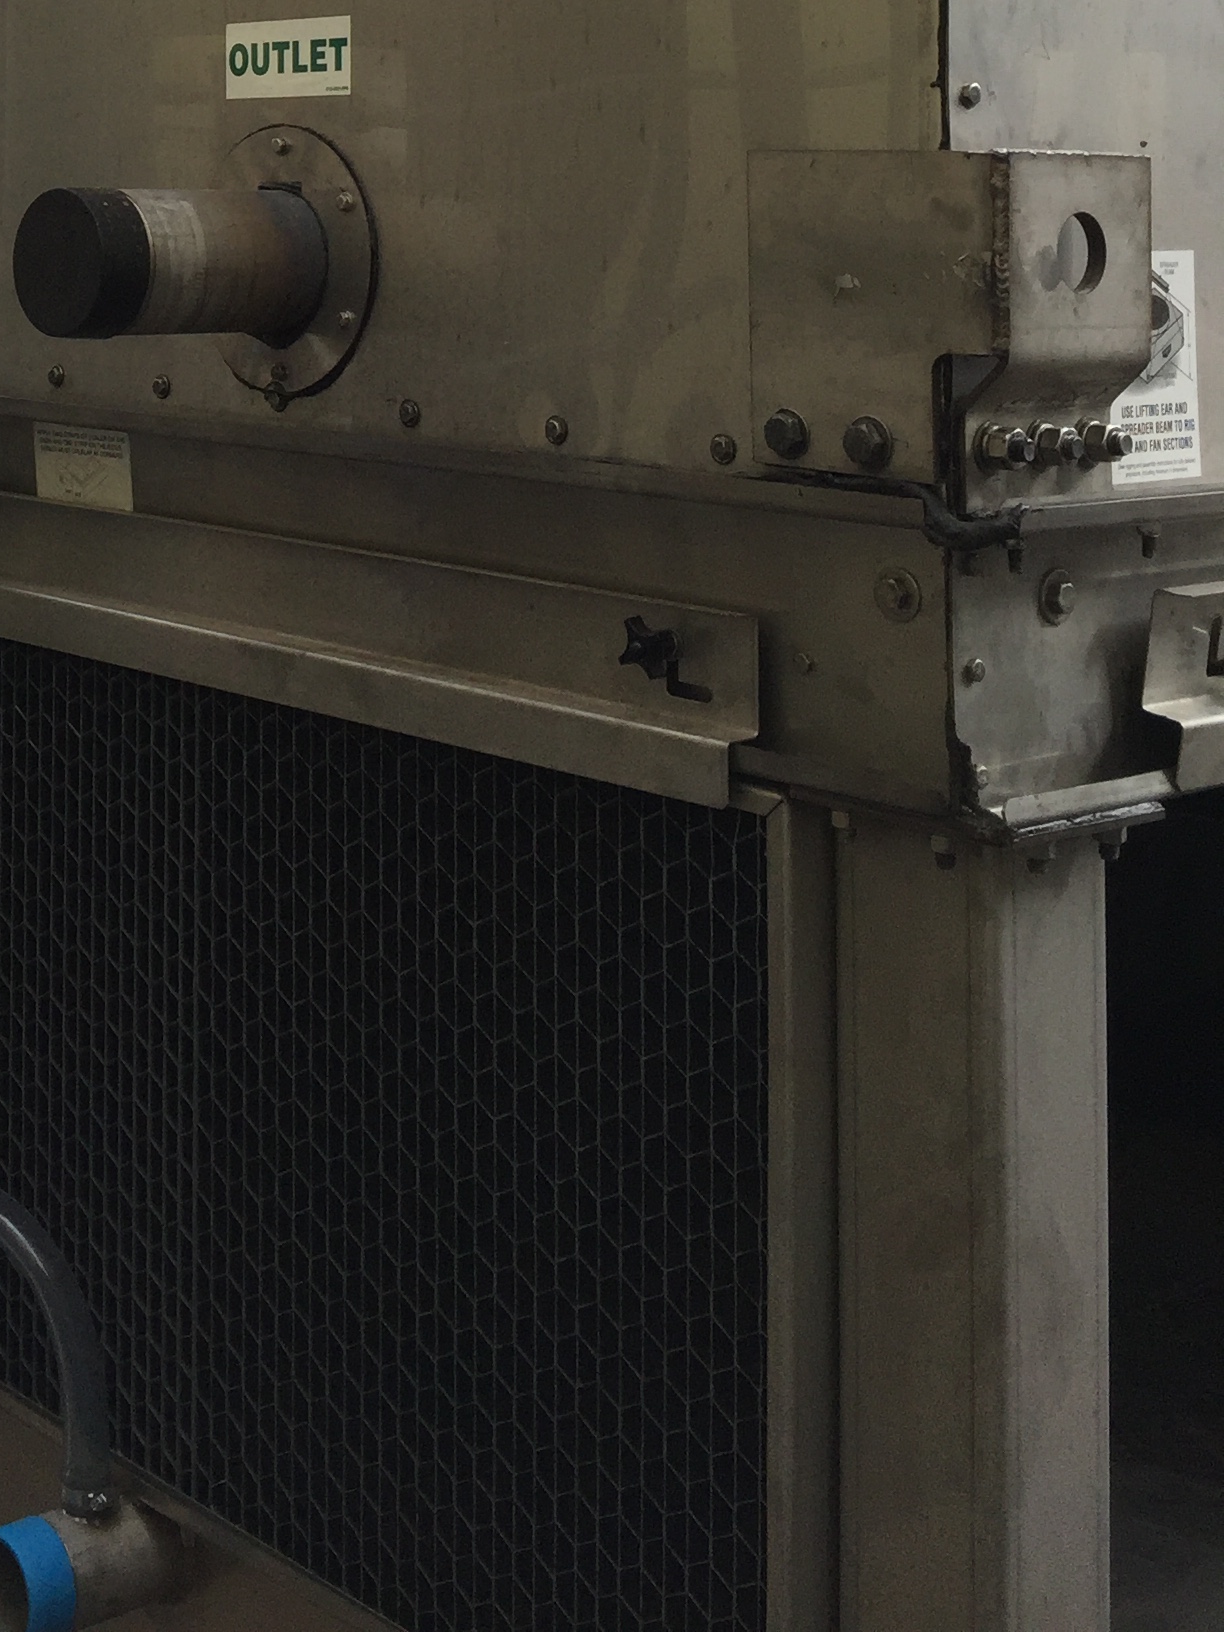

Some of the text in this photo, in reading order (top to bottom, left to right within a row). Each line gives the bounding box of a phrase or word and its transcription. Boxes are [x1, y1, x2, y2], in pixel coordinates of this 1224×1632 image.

[229, 37, 348, 76] OUTLET
[1121, 402, 1187, 418] USE LIFTING EAR AND
[1155, 421, 1172, 433] BEAM
[1174, 420, 1182, 431] TO
[1134, 436, 1193, 452] AND FAN SECTIONS
